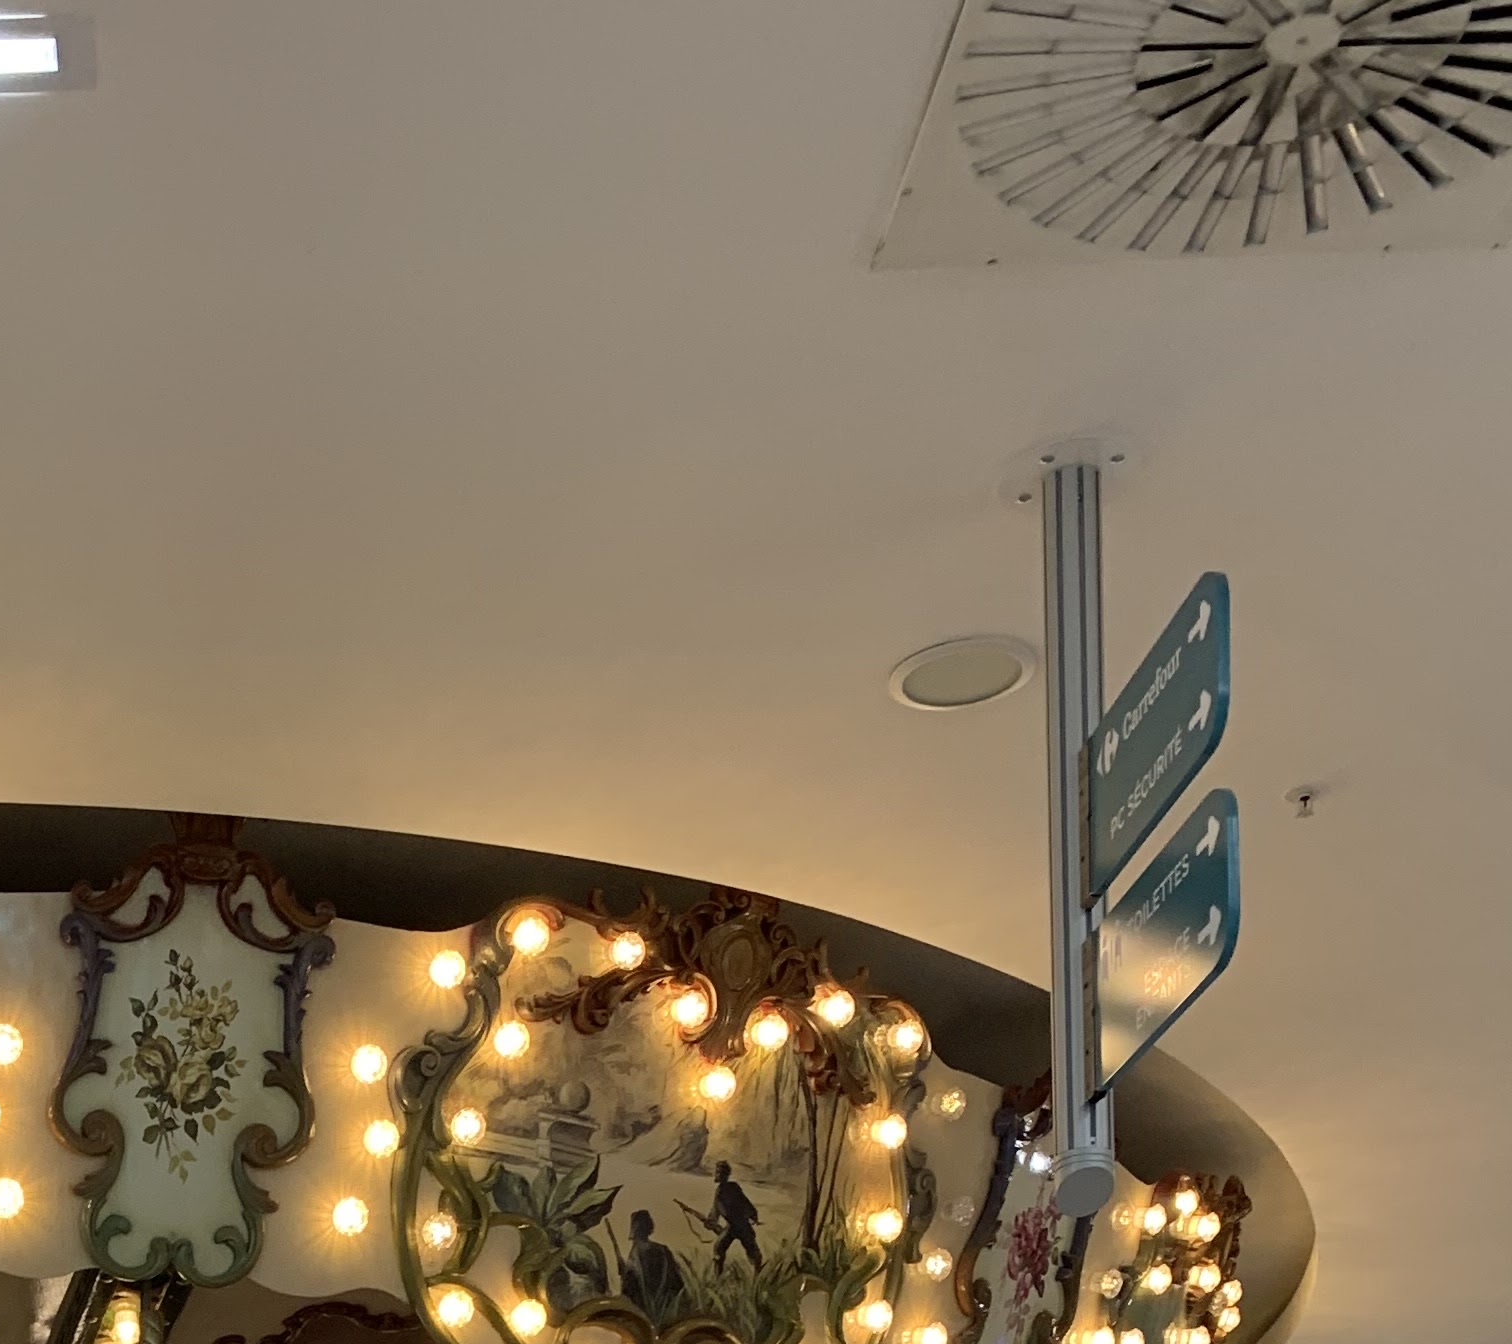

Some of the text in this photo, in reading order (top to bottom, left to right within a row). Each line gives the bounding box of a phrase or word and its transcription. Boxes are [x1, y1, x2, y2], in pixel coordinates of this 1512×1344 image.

[1121, 646, 1183, 741] Carrefour
[1110, 724, 1184, 841] PC SÉCURITÉ
